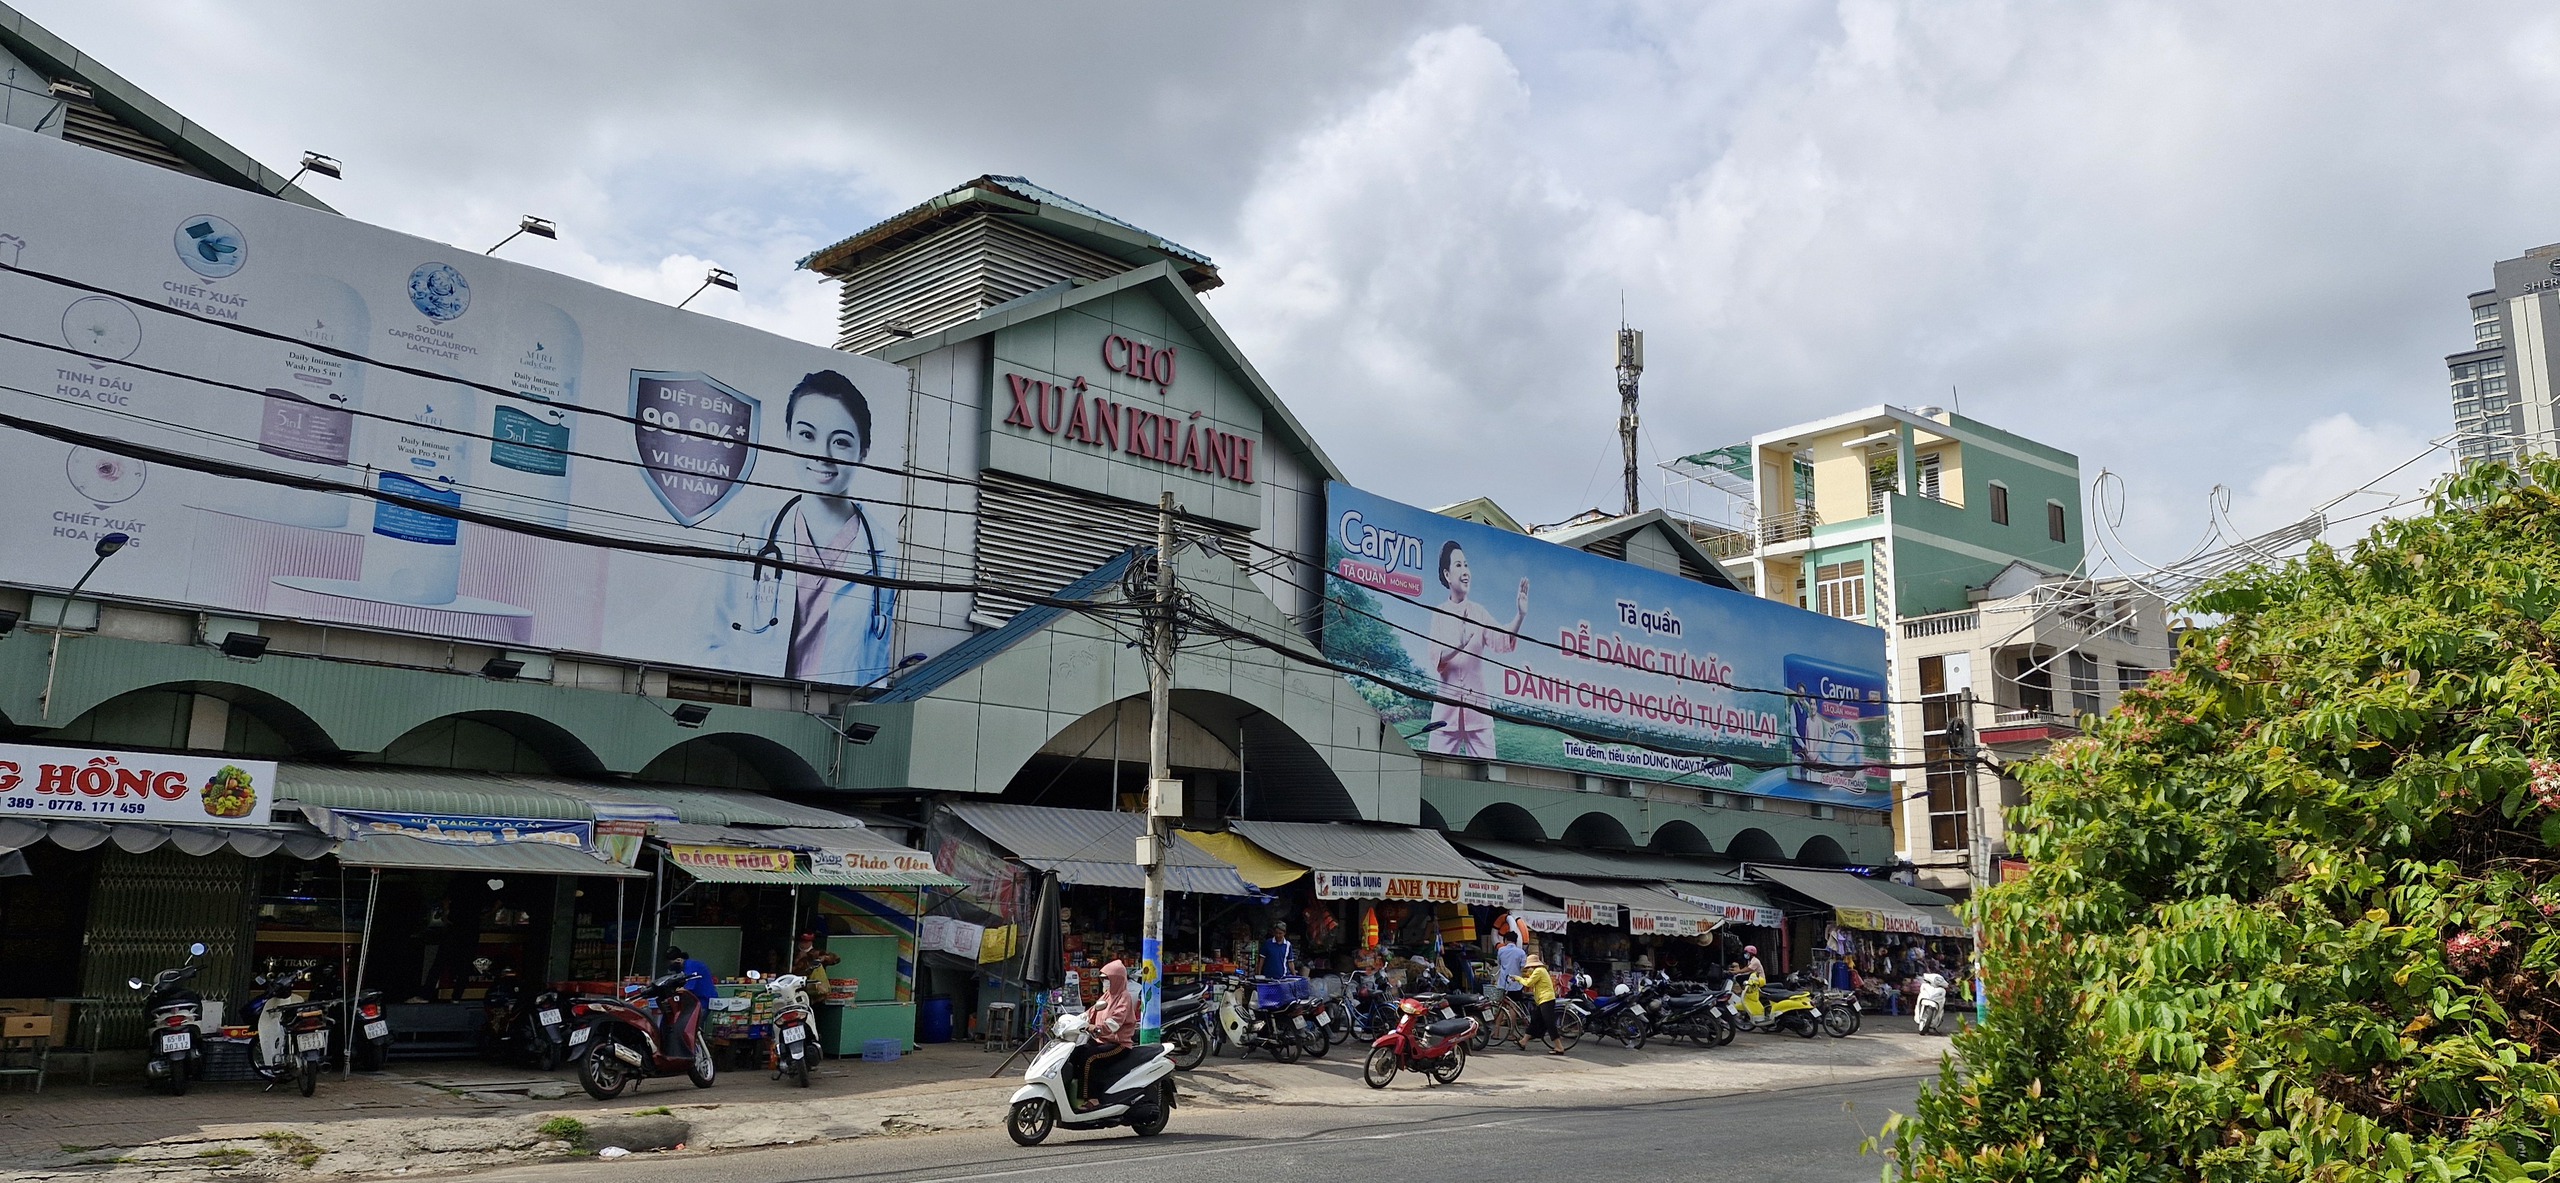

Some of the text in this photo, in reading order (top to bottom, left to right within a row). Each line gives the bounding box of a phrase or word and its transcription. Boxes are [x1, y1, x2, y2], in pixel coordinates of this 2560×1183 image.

[163, 281, 248, 308] CHIẾT XUẤT
[169, 296, 238, 320] NHA ĐAM
[416, 325, 454, 339] SODIUM
[388, 329, 478, 355] CAPROYL/LAUROYL
[289, 352, 342, 369] Daily Intimate
[406, 343, 460, 360] LACTYLATE
[285, 361, 306, 371] Wash
[308, 365, 320, 374] Pro
[1104, 334, 1178, 395] CHỢ
[57, 369, 94, 385] TINH
[511, 380, 529, 390] Wash
[530, 384, 541, 392] Pro
[514, 371, 559, 387] Daily Intimate
[57, 384, 129, 406] HOA CÚC
[660, 387, 733, 415] DIỆT ĐẾN
[1004, 372, 1256, 484] XUÂN KHÁNH
[397, 445, 417, 455] Wash
[418, 449, 430, 458] Pro
[400, 436, 450, 451] Daily Intimate
[652, 449, 669, 464] VI
[661, 473, 677, 488] VI
[53, 511, 146, 533] CHIẾT XUẤT
[53, 526, 89, 540] HOA
[1339, 509, 1423, 574] Caryn
[1343, 562, 1356, 578] TÃ
[1357, 567, 1387, 585] QUẦN
[1618, 602, 1681, 635] Tã quần
[1561, 623, 1732, 692] DỄ DÀNG TỰ MẶC
[1504, 665, 1776, 745] DÀNH CHO NGƯỜI TỰ ĐI LẠI
[1565, 740, 1584, 755] Tiểu
[1586, 743, 1607, 761] đêm,
[1608, 747, 1625, 762] tiểu
[1627, 751, 1641, 765] són
[1643, 751, 1670, 768] DÙNG
[1671, 757, 1694, 772] NGAY
[35, 755, 189, 800] HỒNG
[7, 797, 34, 808] 389
[48, 799, 86, 811] 0778.
[92, 801, 114, 812] 171
[120, 802, 145, 813] 459
[679, 850, 729, 866] BÁCH
[777, 853, 789, 869] 9
[814, 852, 842, 867] Shop
[845, 853, 889, 869] Thảo
[1332, 873, 1348, 889] ĐIỆN
[1363, 876, 1382, 890] DỤNG
[1385, 878, 1461, 900] ANH THƯ
[1886, 915, 1904, 931] BÁCH
[285, 958, 317, 967] TRANG
